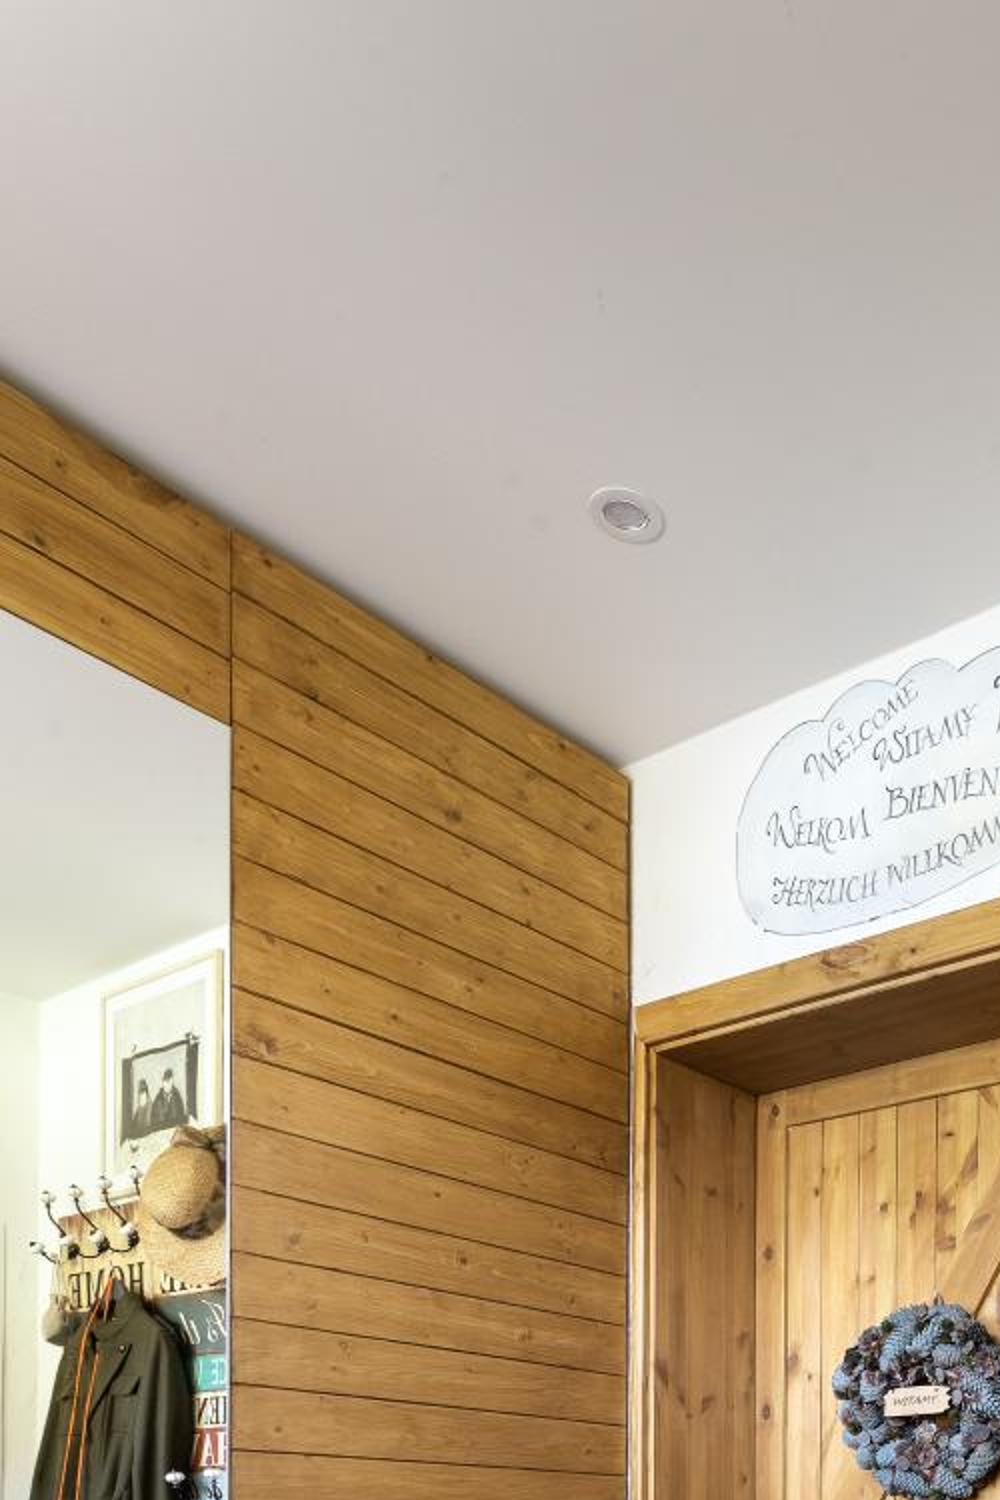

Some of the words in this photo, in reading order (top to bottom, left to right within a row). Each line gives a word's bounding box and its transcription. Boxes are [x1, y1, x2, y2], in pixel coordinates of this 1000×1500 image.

[803, 679, 919, 782] WELCOME
[766, 804, 871, 854] WELKOM
[772, 869, 880, 912] HERZLICH
